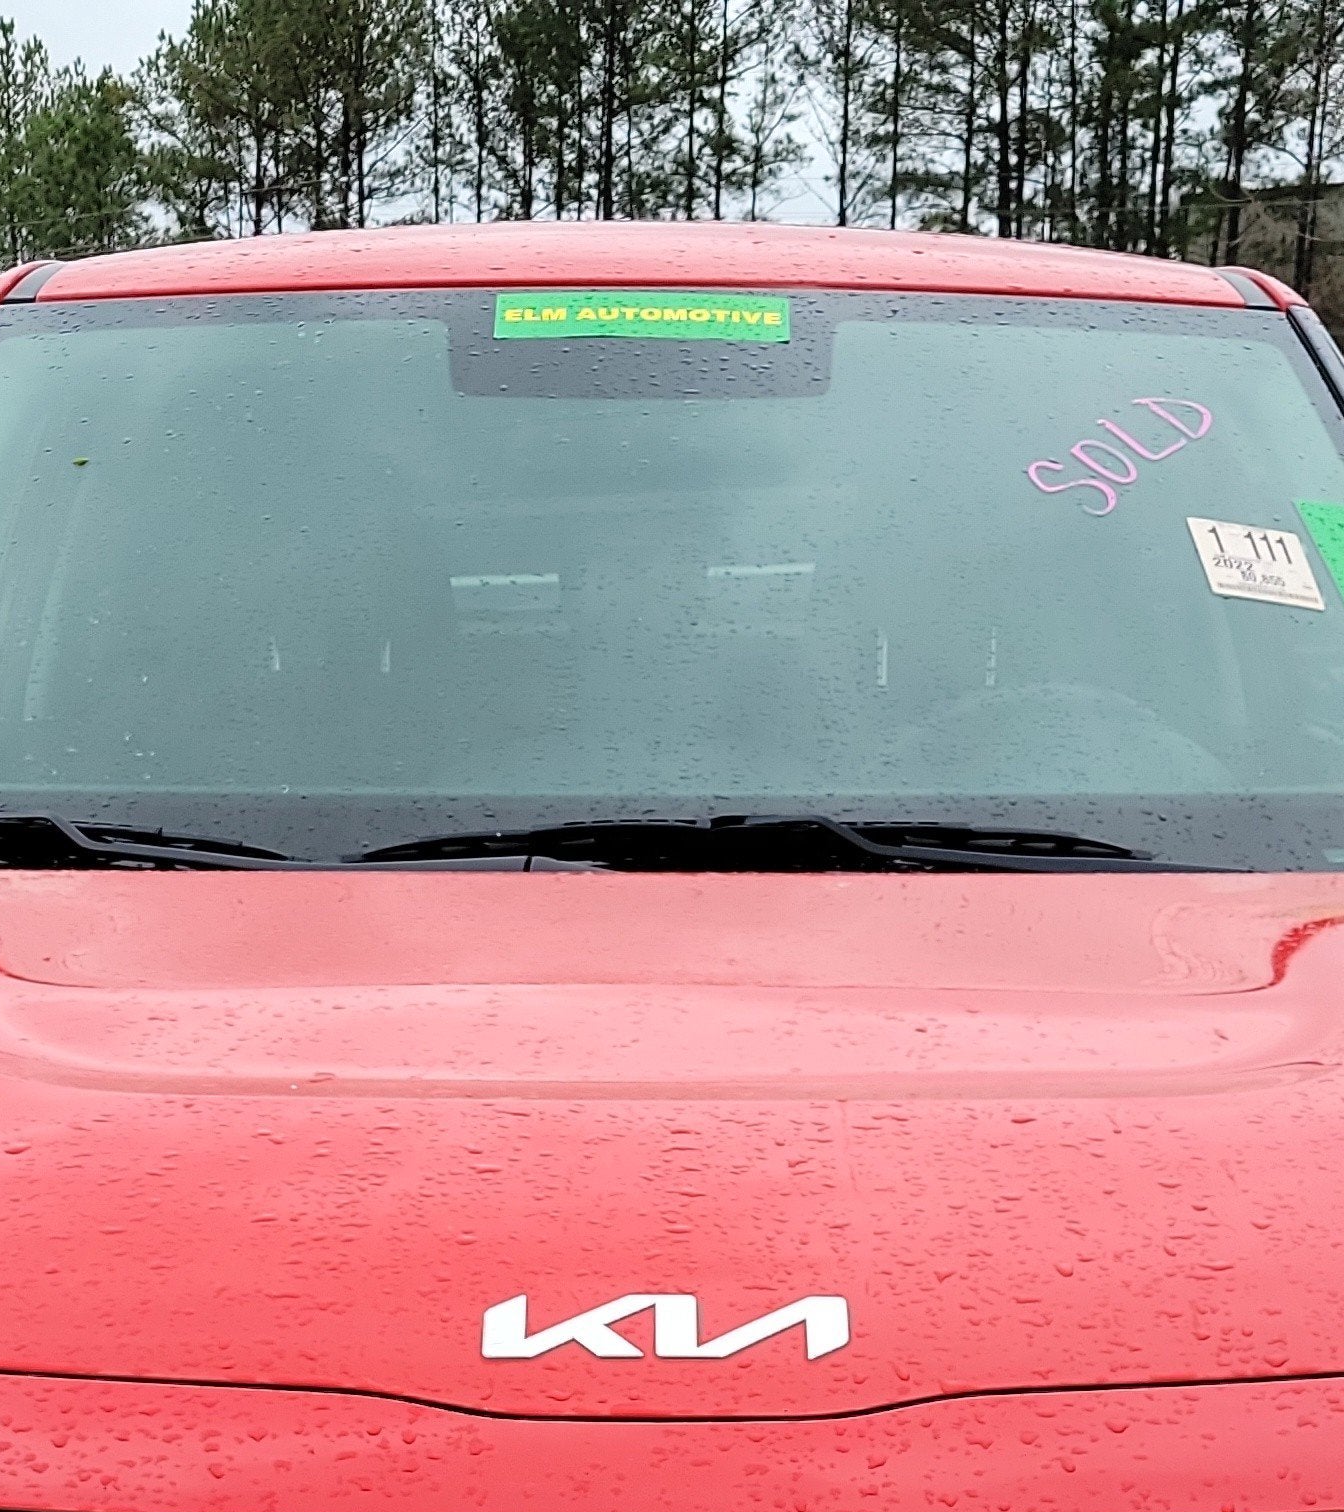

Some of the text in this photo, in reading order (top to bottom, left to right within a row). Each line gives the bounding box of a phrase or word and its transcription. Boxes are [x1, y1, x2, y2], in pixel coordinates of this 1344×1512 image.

[503, 306, 783, 326] ELM AUTOMOTIVE
[1027, 397, 1213, 517] SOLD
[1207, 526, 1292, 564] 1 111
